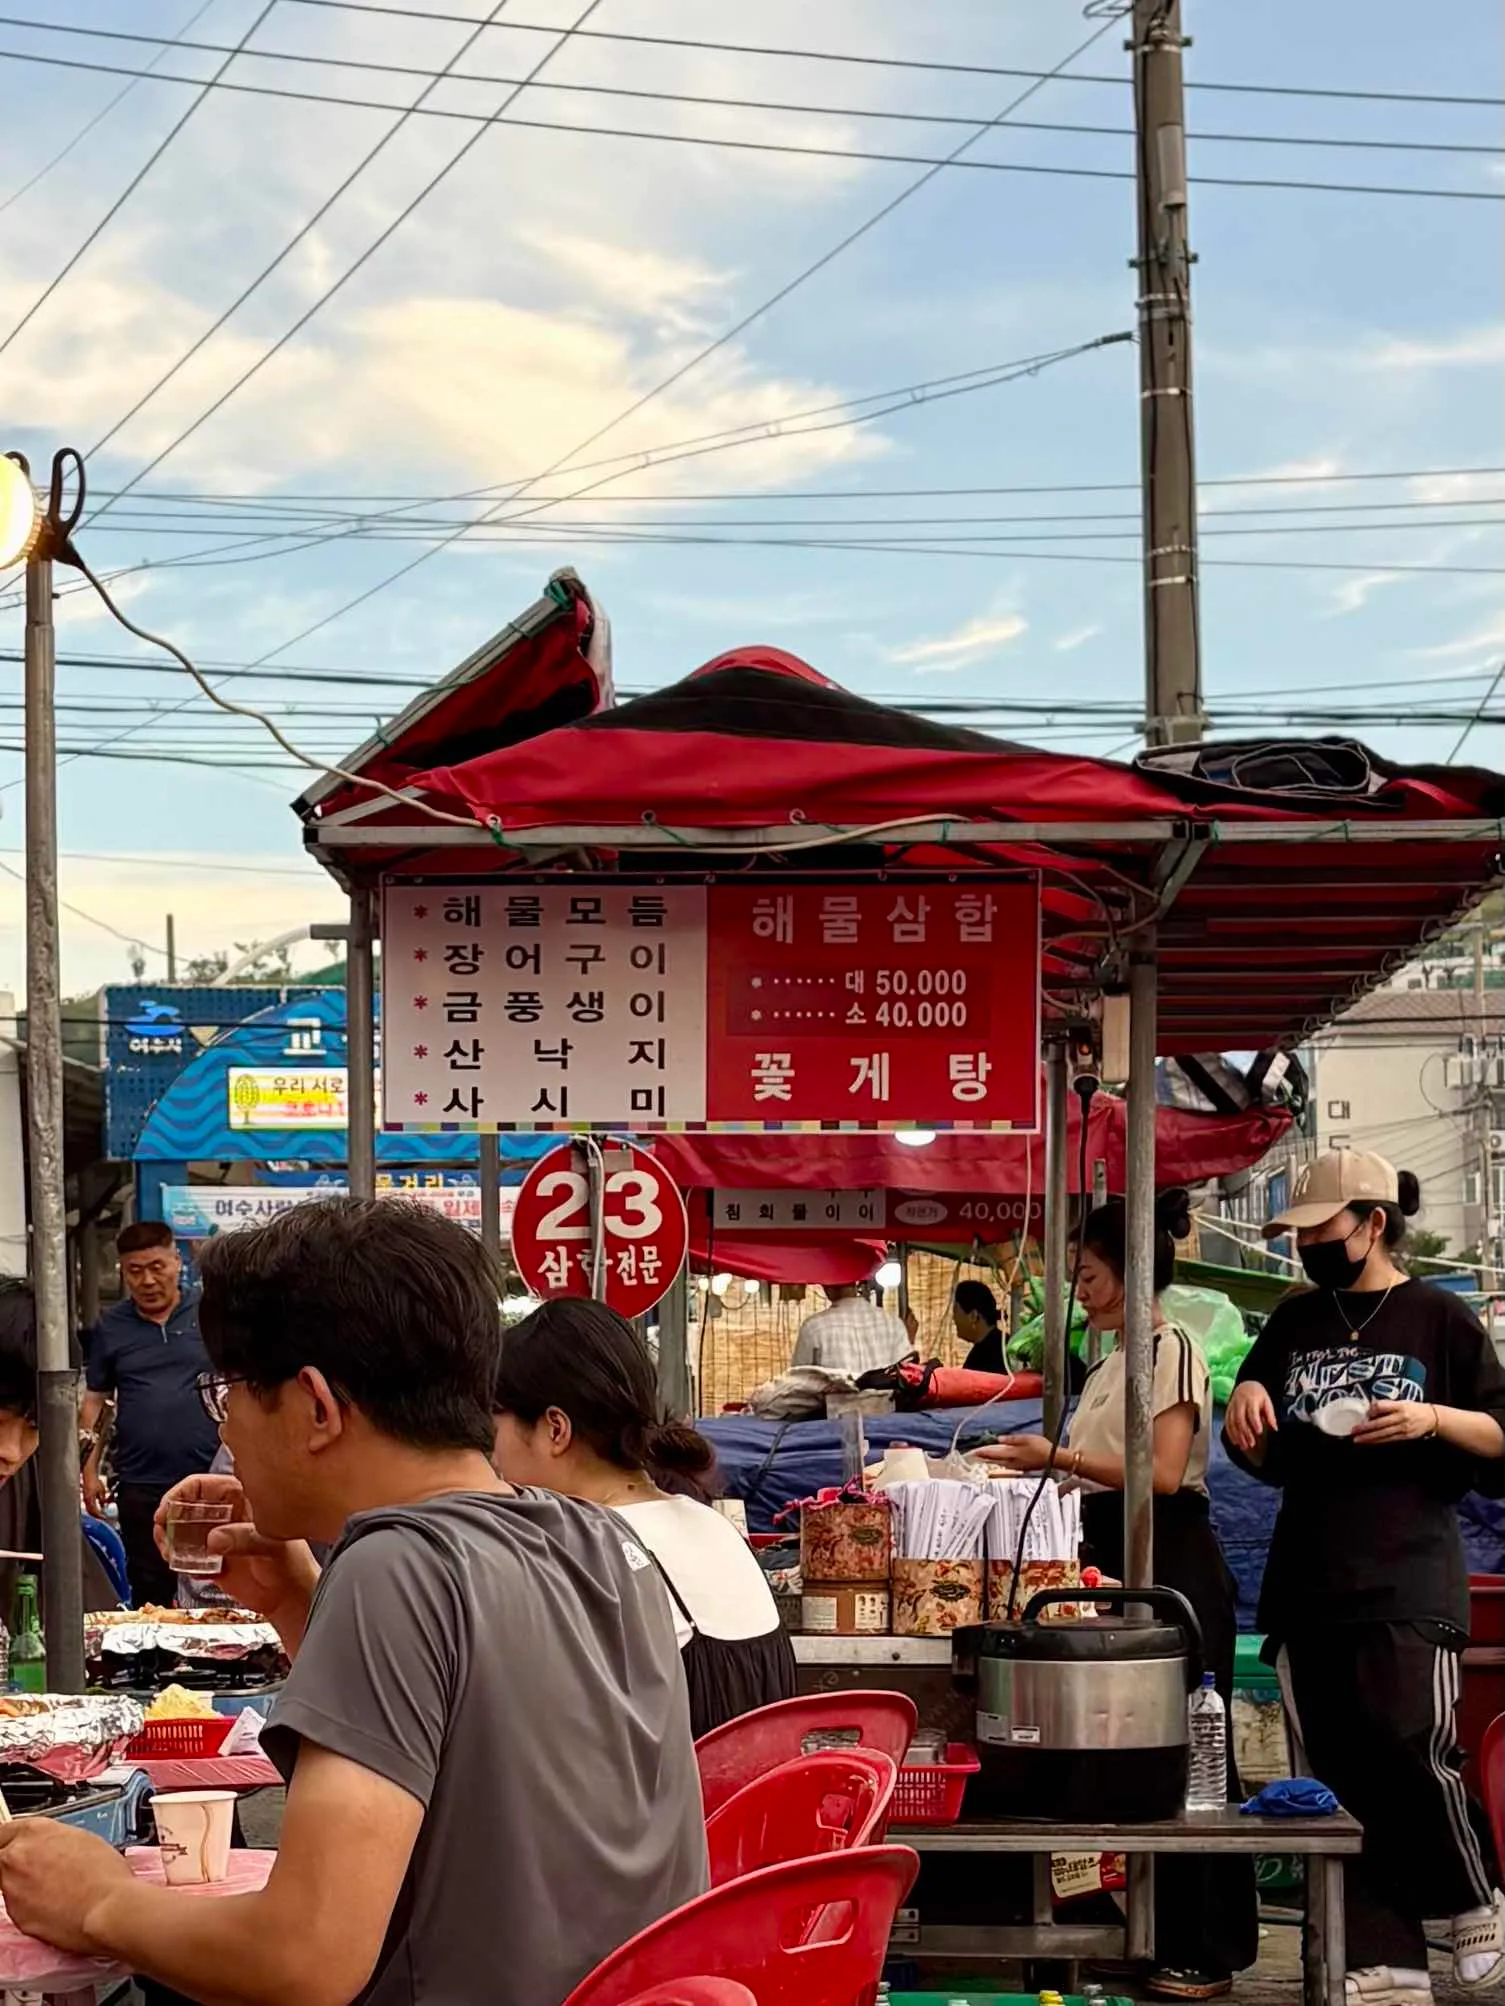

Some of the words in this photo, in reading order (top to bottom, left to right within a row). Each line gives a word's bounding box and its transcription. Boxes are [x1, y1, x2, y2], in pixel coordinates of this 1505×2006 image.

[845, 970, 865, 993] 대
[875, 969, 967, 995] 50.000
[845, 1002, 867, 1024] 소
[875, 1001, 967, 1027] 40.000
[273, 1076, 305, 1096] 우리
[536, 1170, 663, 1240] 23
[959, 1202, 1042, 1222] 40,000
